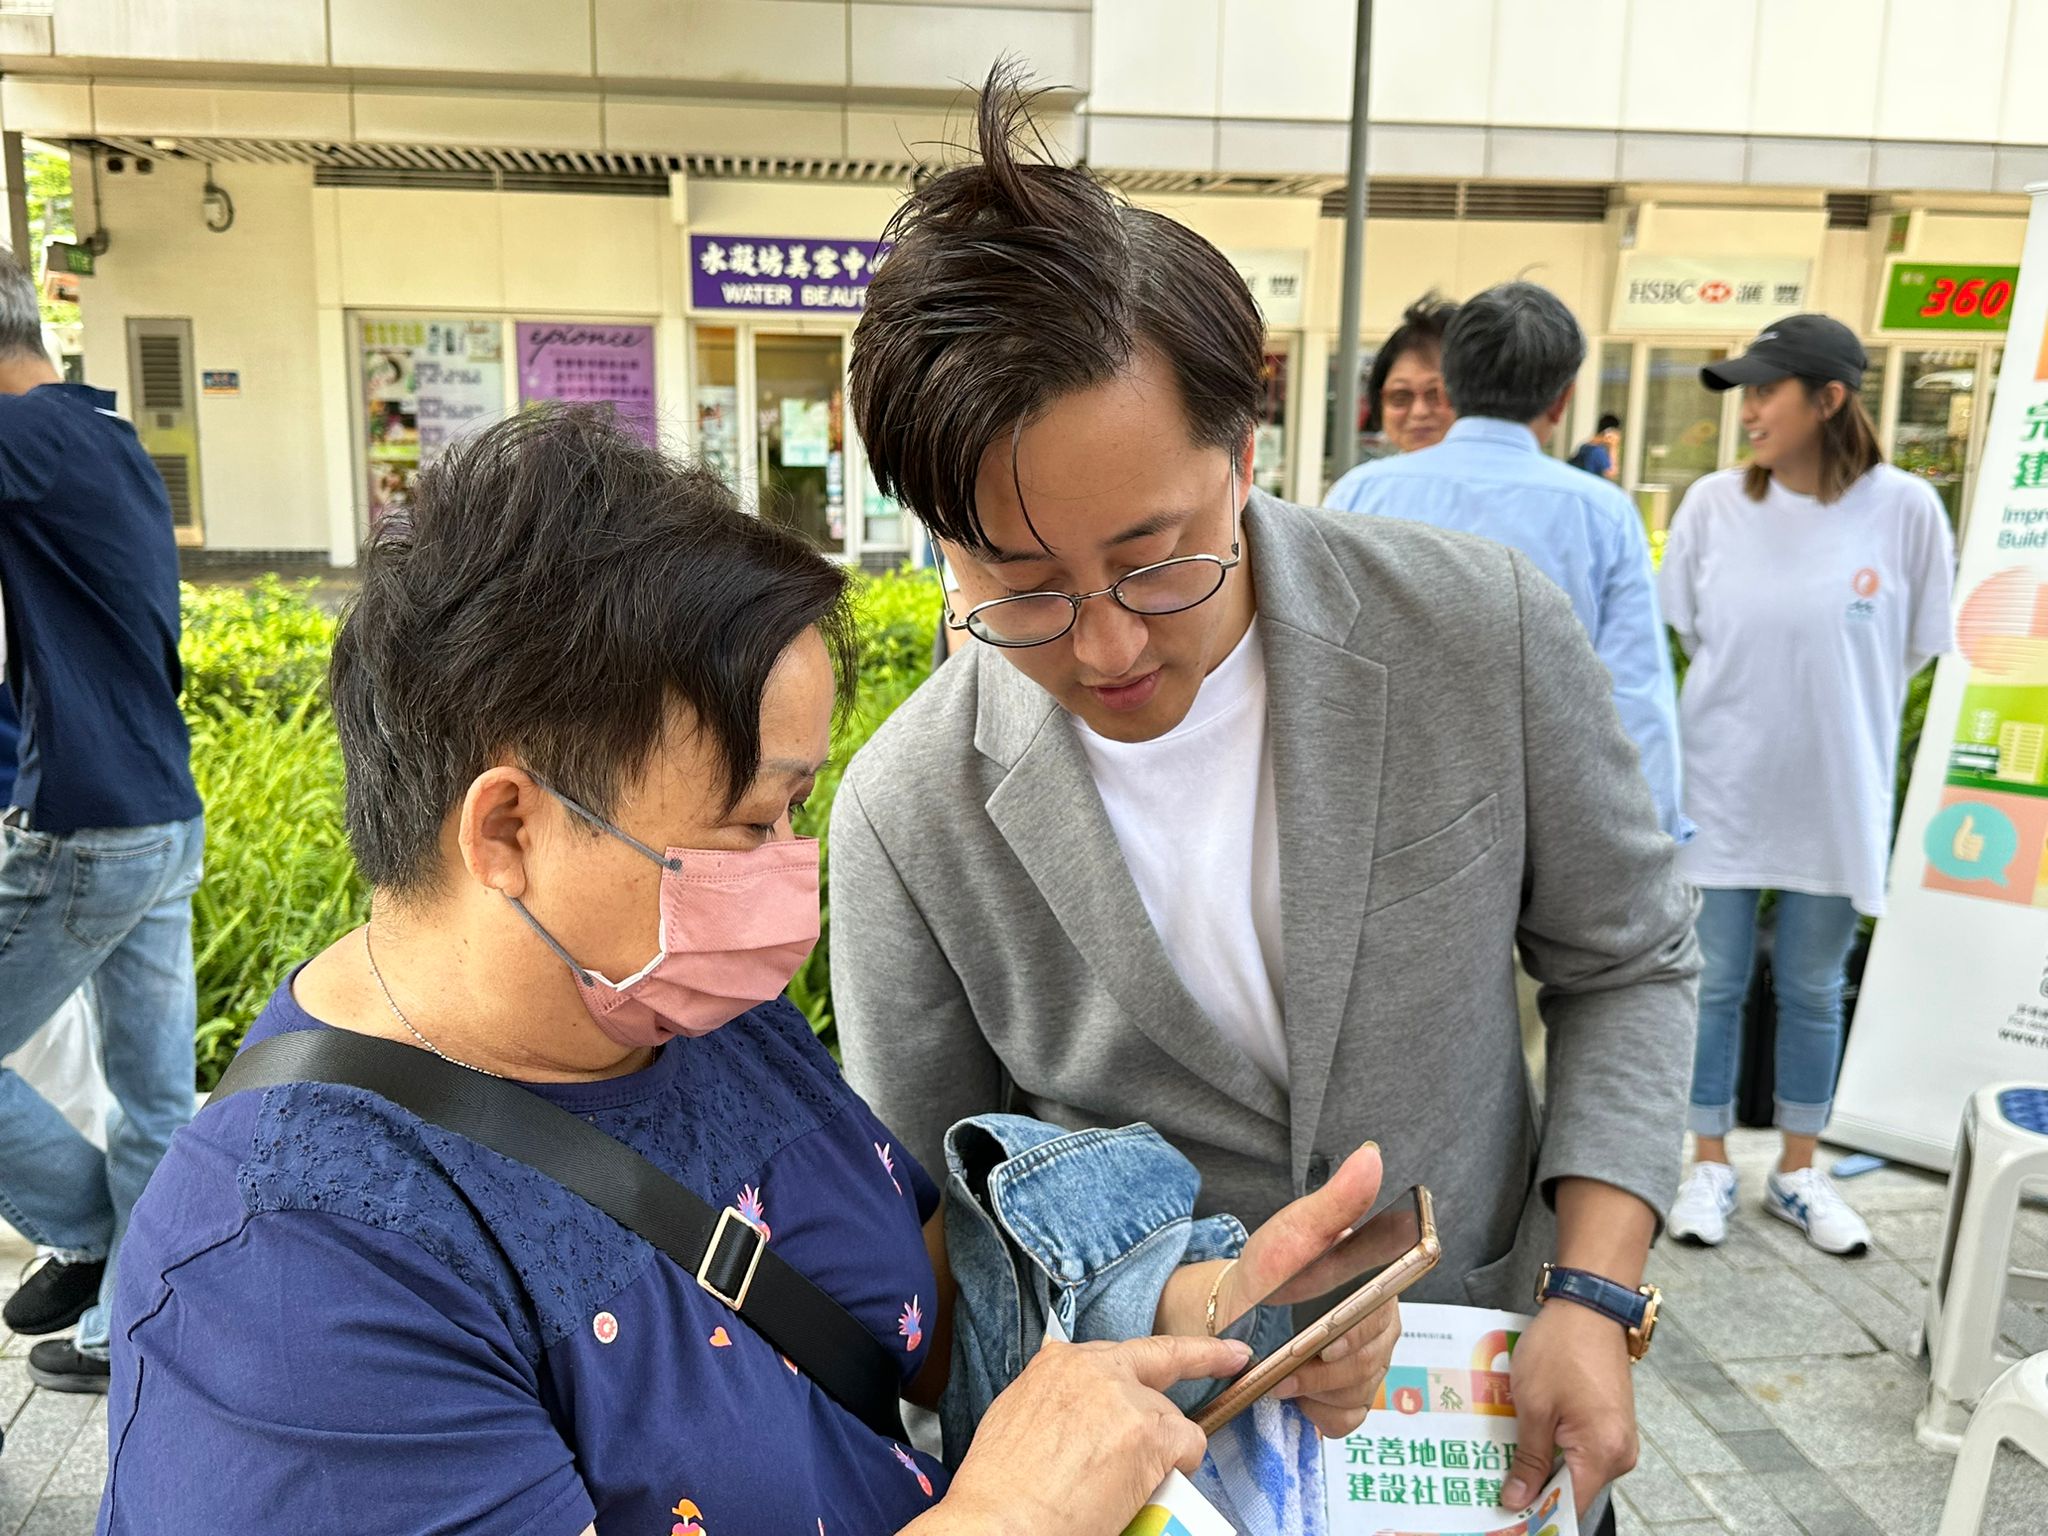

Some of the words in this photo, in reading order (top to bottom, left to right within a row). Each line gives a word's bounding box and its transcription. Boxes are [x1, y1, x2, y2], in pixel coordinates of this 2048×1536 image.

[721, 282, 792, 305] WATER
[1628, 279, 1696, 304] HSBC
[1920, 278, 2012, 318] 360
[528, 327, 646, 367] epionce
